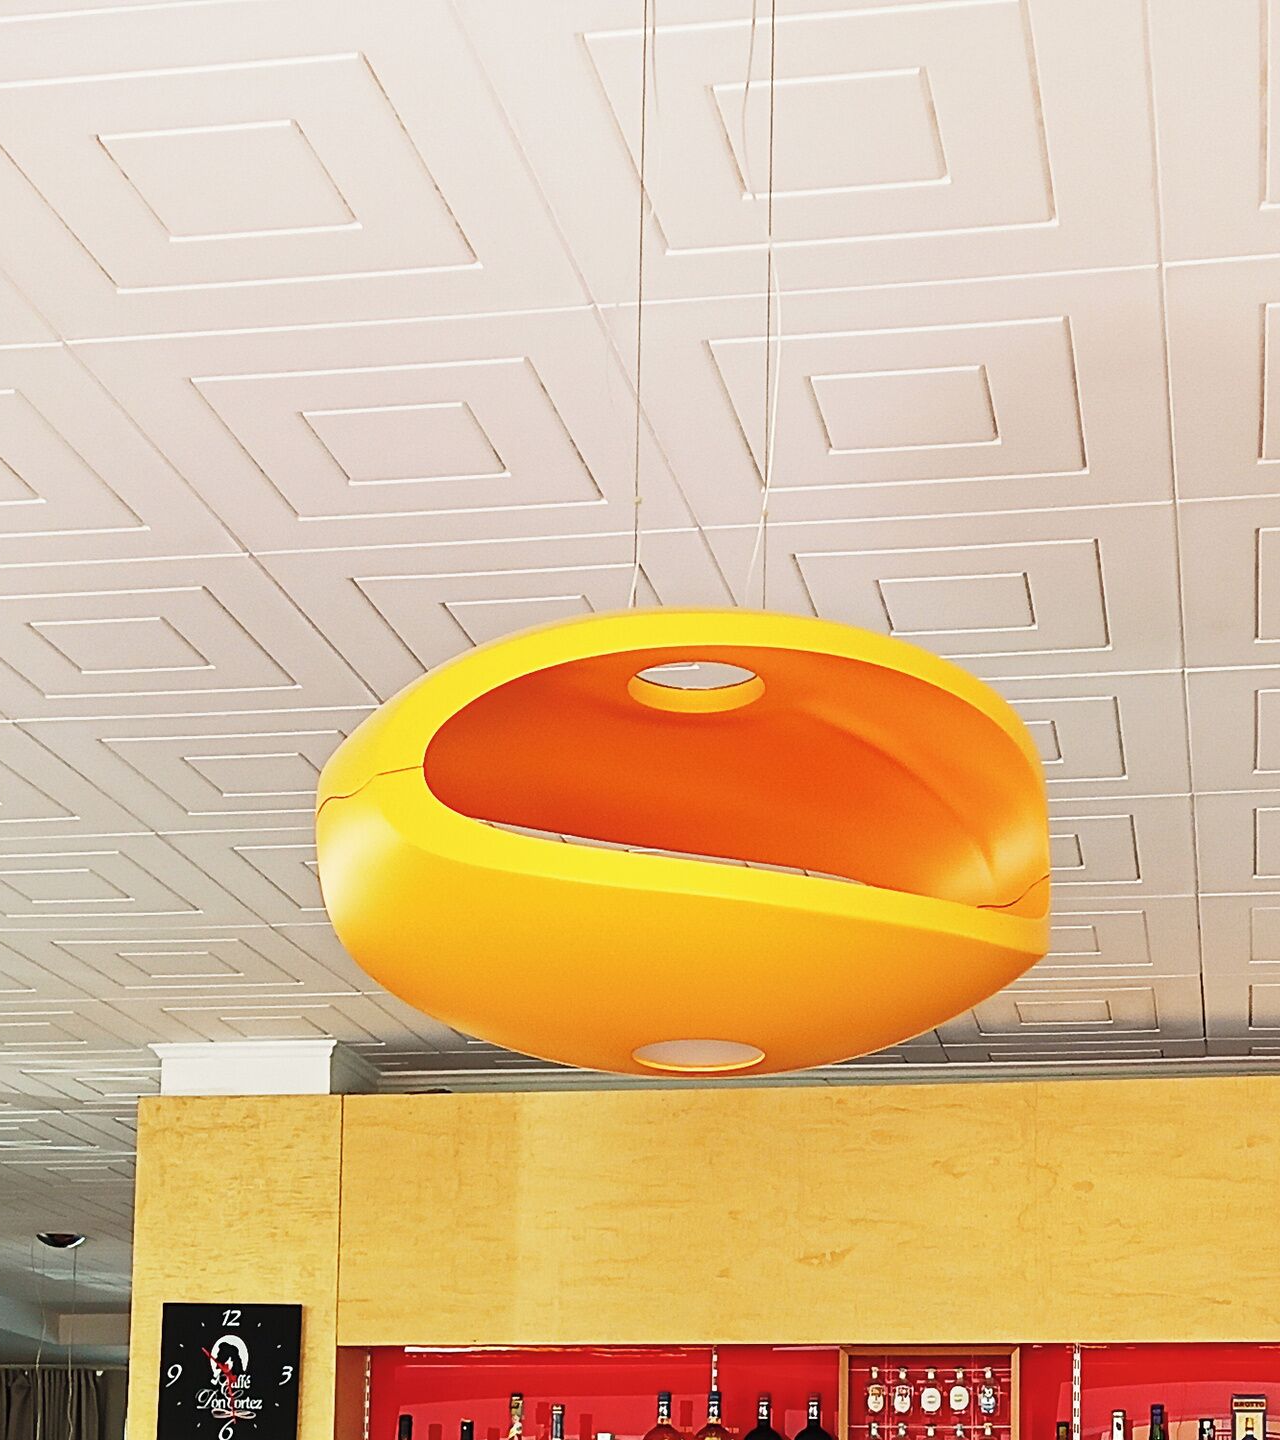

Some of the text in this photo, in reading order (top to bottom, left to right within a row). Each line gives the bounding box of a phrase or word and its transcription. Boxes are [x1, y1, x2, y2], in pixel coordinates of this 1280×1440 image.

[222, 1310, 241, 1327] 12
[166, 1364, 182, 1387] 9
[279, 1366, 293, 1385] 3
[218, 1419, 235, 1440] 6
